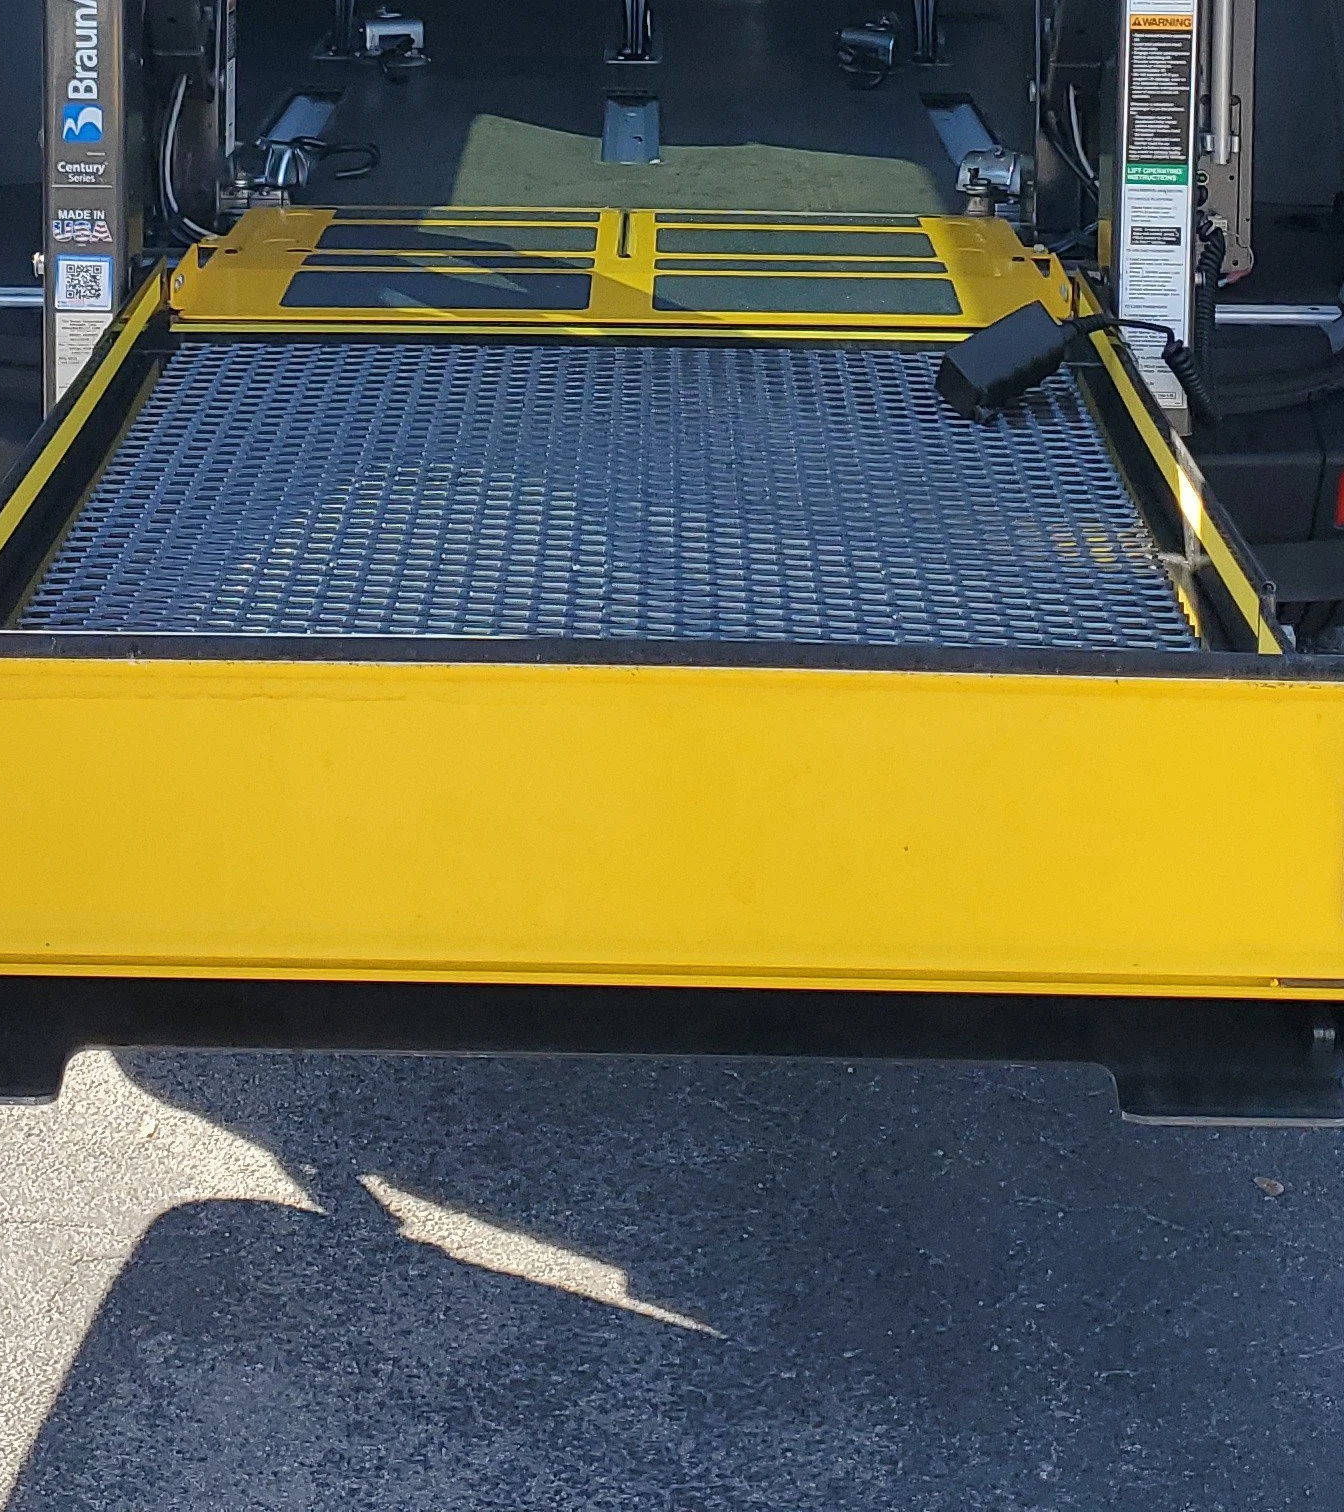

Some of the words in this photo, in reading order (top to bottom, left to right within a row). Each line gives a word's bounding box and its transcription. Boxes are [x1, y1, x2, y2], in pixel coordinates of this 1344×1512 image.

[1142, 17, 1191, 27] WARNING
[57, 161, 106, 175] Century
[68, 173, 96, 183] Series
[58, 209, 91, 220] MADE
[93, 209, 105, 220] IN
[53, 220, 113, 242] USA
